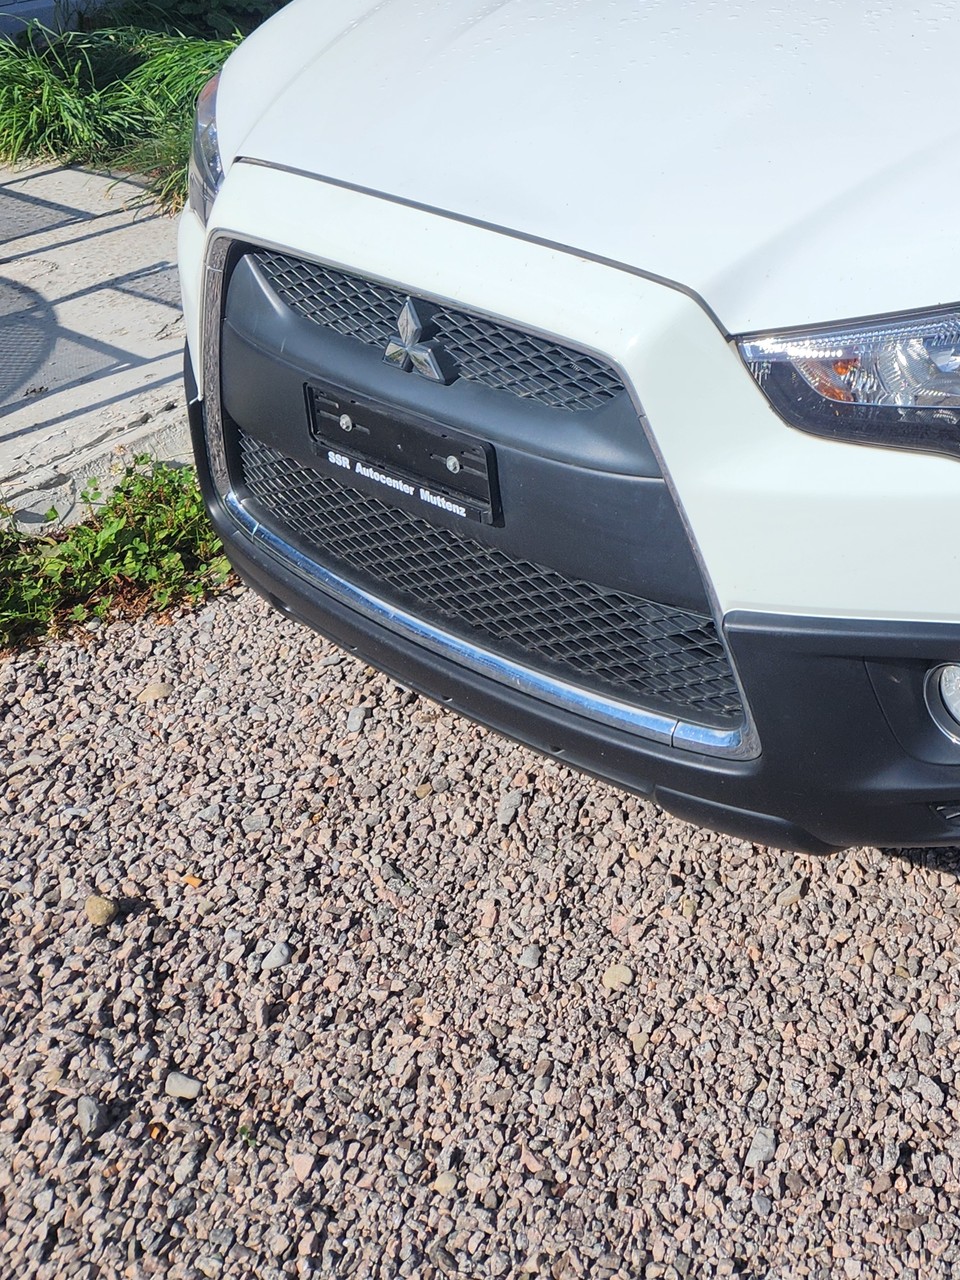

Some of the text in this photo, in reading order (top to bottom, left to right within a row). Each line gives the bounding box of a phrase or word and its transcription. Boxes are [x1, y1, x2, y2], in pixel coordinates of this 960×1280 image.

[327, 450, 467, 518] SSR Autocenter Muttenz
